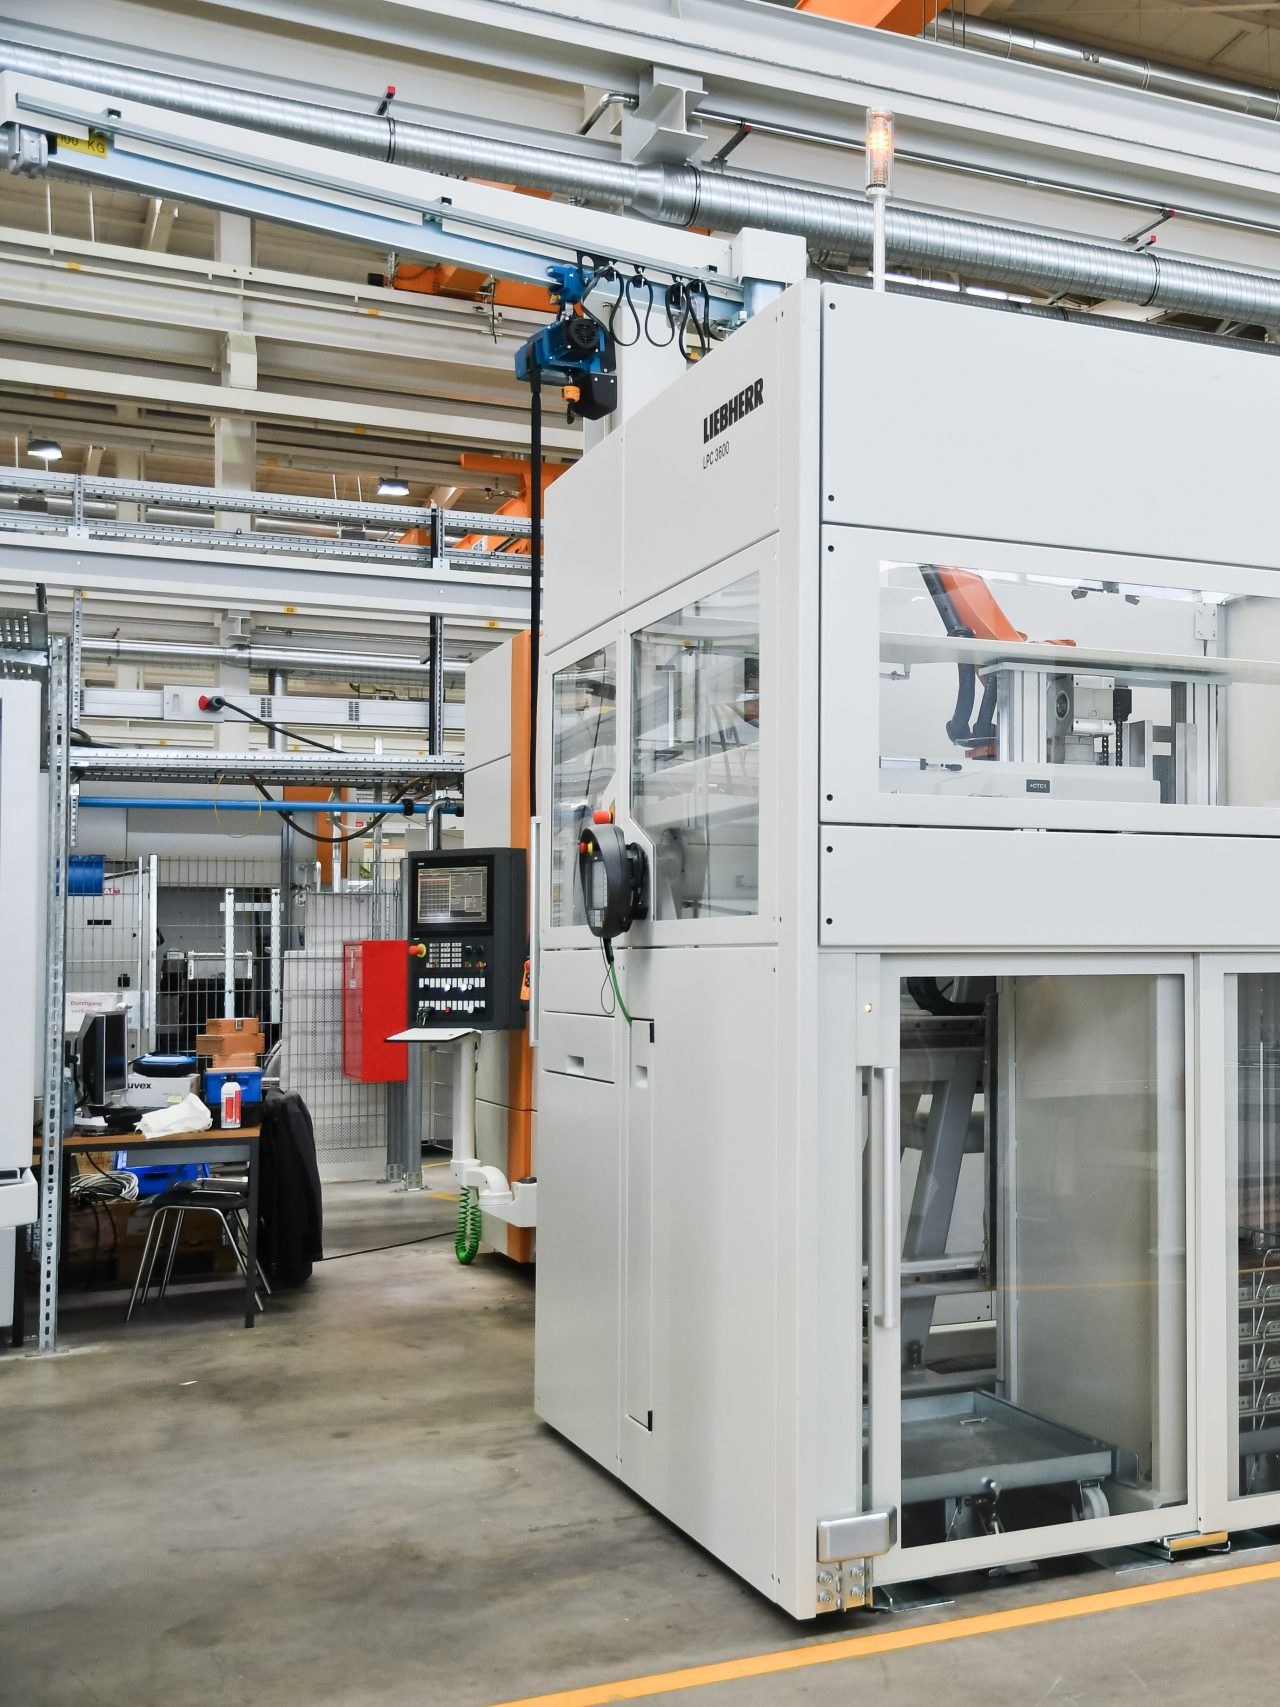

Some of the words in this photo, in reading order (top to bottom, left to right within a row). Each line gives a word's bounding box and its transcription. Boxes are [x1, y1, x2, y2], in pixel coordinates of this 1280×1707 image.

[88, 140, 105, 153] KG
[704, 378, 763, 444] LIEBHERR
[703, 451, 713, 469] LPC
[715, 441, 729, 461] 3600
[127, 1082, 152, 1090] uvex
